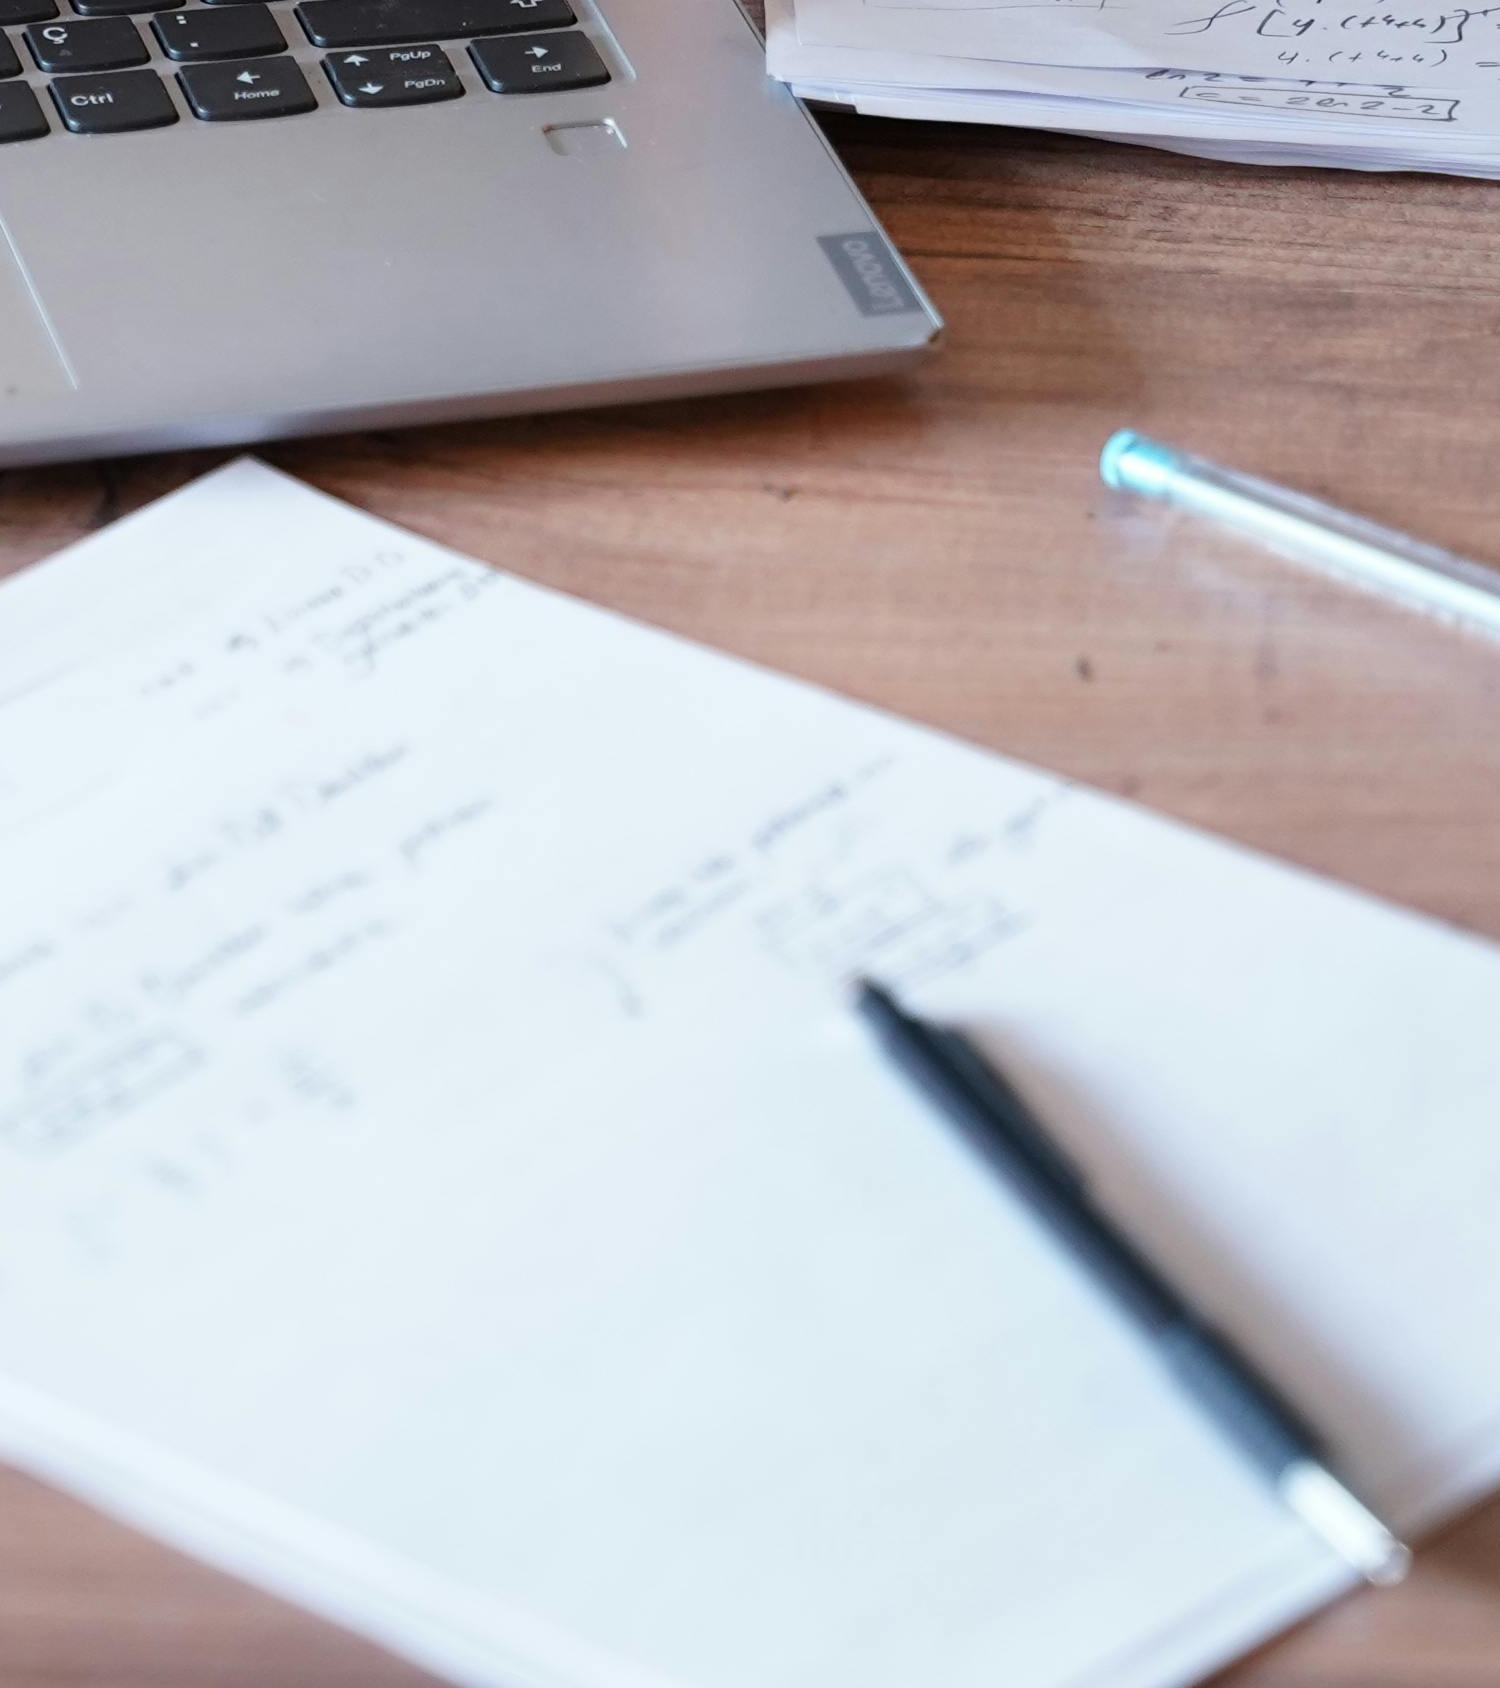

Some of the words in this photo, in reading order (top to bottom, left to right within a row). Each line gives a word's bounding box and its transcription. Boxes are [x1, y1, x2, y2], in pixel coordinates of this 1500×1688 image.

[41, 25, 68, 46] Ç
[69, 90, 115, 109] Ctrl
[232, 87, 282, 102] Home
[388, 48, 433, 65] PgUp
[531, 61, 563, 75] End
[404, 75, 447, 91] PgDn
